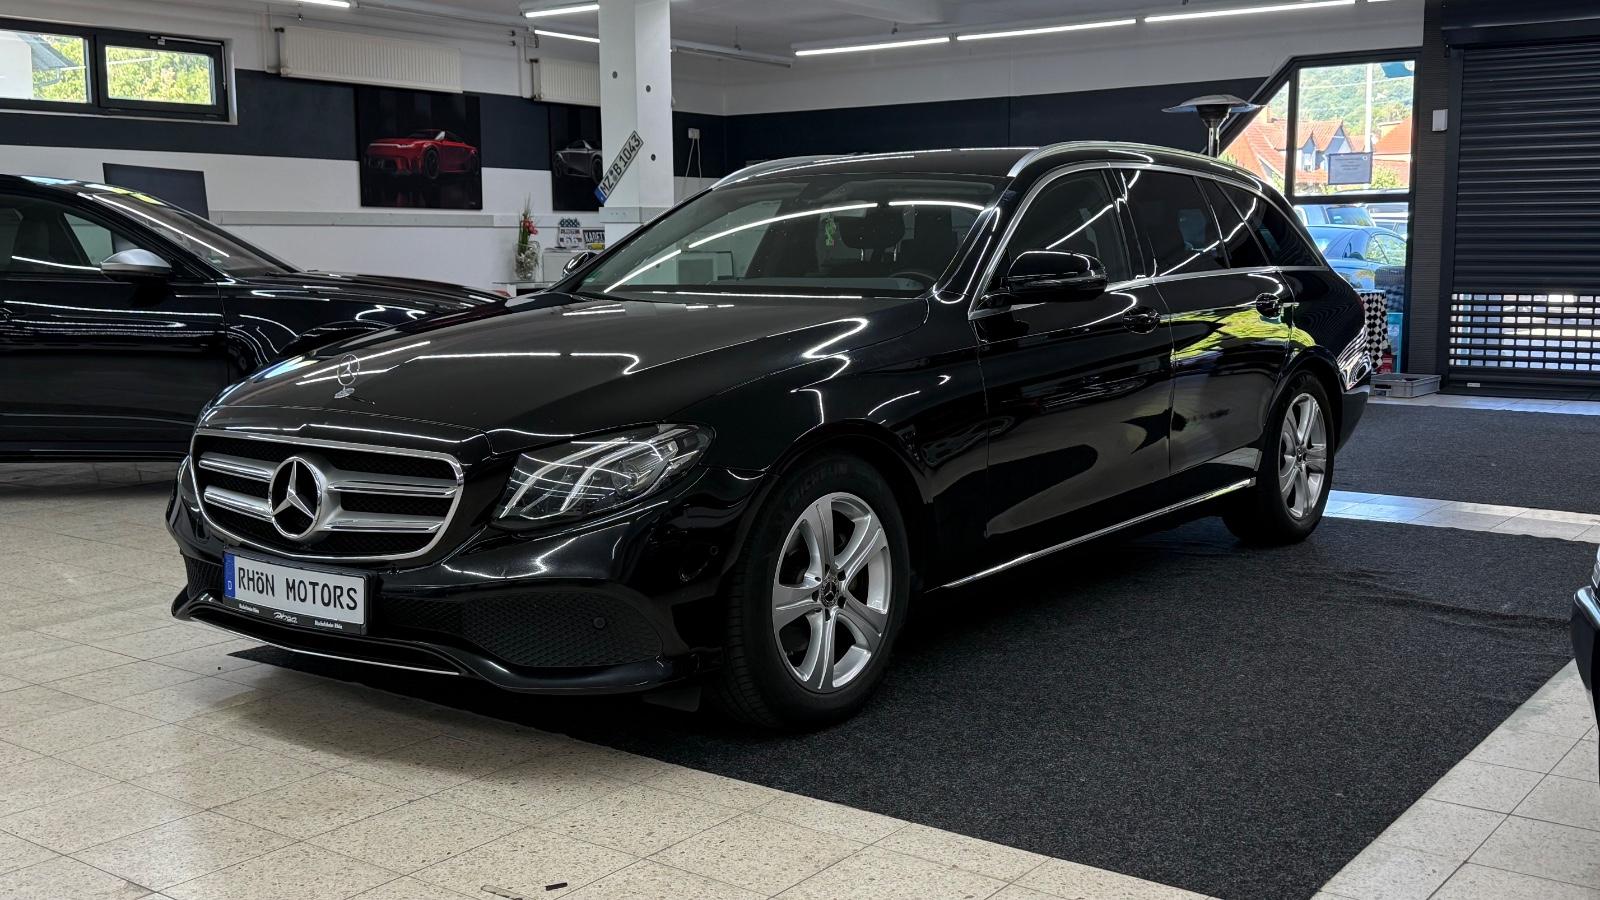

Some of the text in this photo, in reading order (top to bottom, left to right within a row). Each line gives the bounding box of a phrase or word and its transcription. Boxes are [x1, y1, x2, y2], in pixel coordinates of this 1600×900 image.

[600, 134, 641, 196] MZ B 1043
[285, 577, 358, 611] MOTORS
